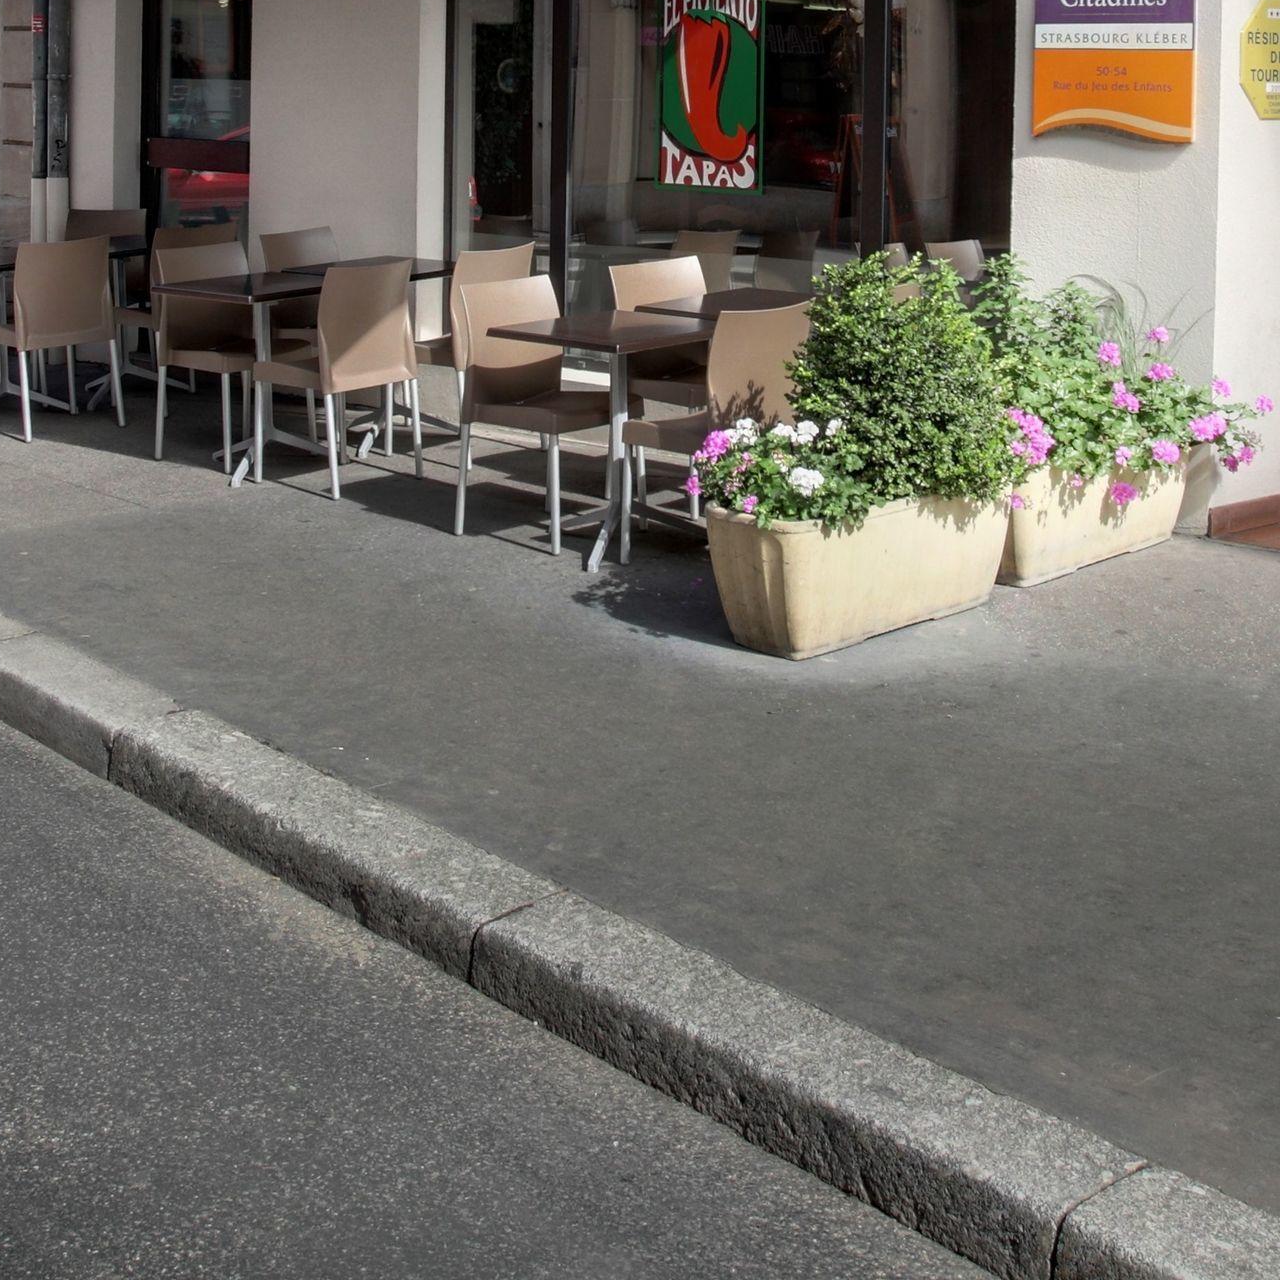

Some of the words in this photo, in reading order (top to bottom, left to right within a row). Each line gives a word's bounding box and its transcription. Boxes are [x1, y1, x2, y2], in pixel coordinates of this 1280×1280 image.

[1041, 33, 1130, 44] STRASBOURG
[1136, 30, 1188, 44] KLÉBER
[1053, 81, 1071, 90] Rue
[1075, 81, 1088, 90] du
[1111, 81, 1129, 91] des
[1134, 82, 1172, 92] Enfants
[662, 130, 755, 189] TAPAS
